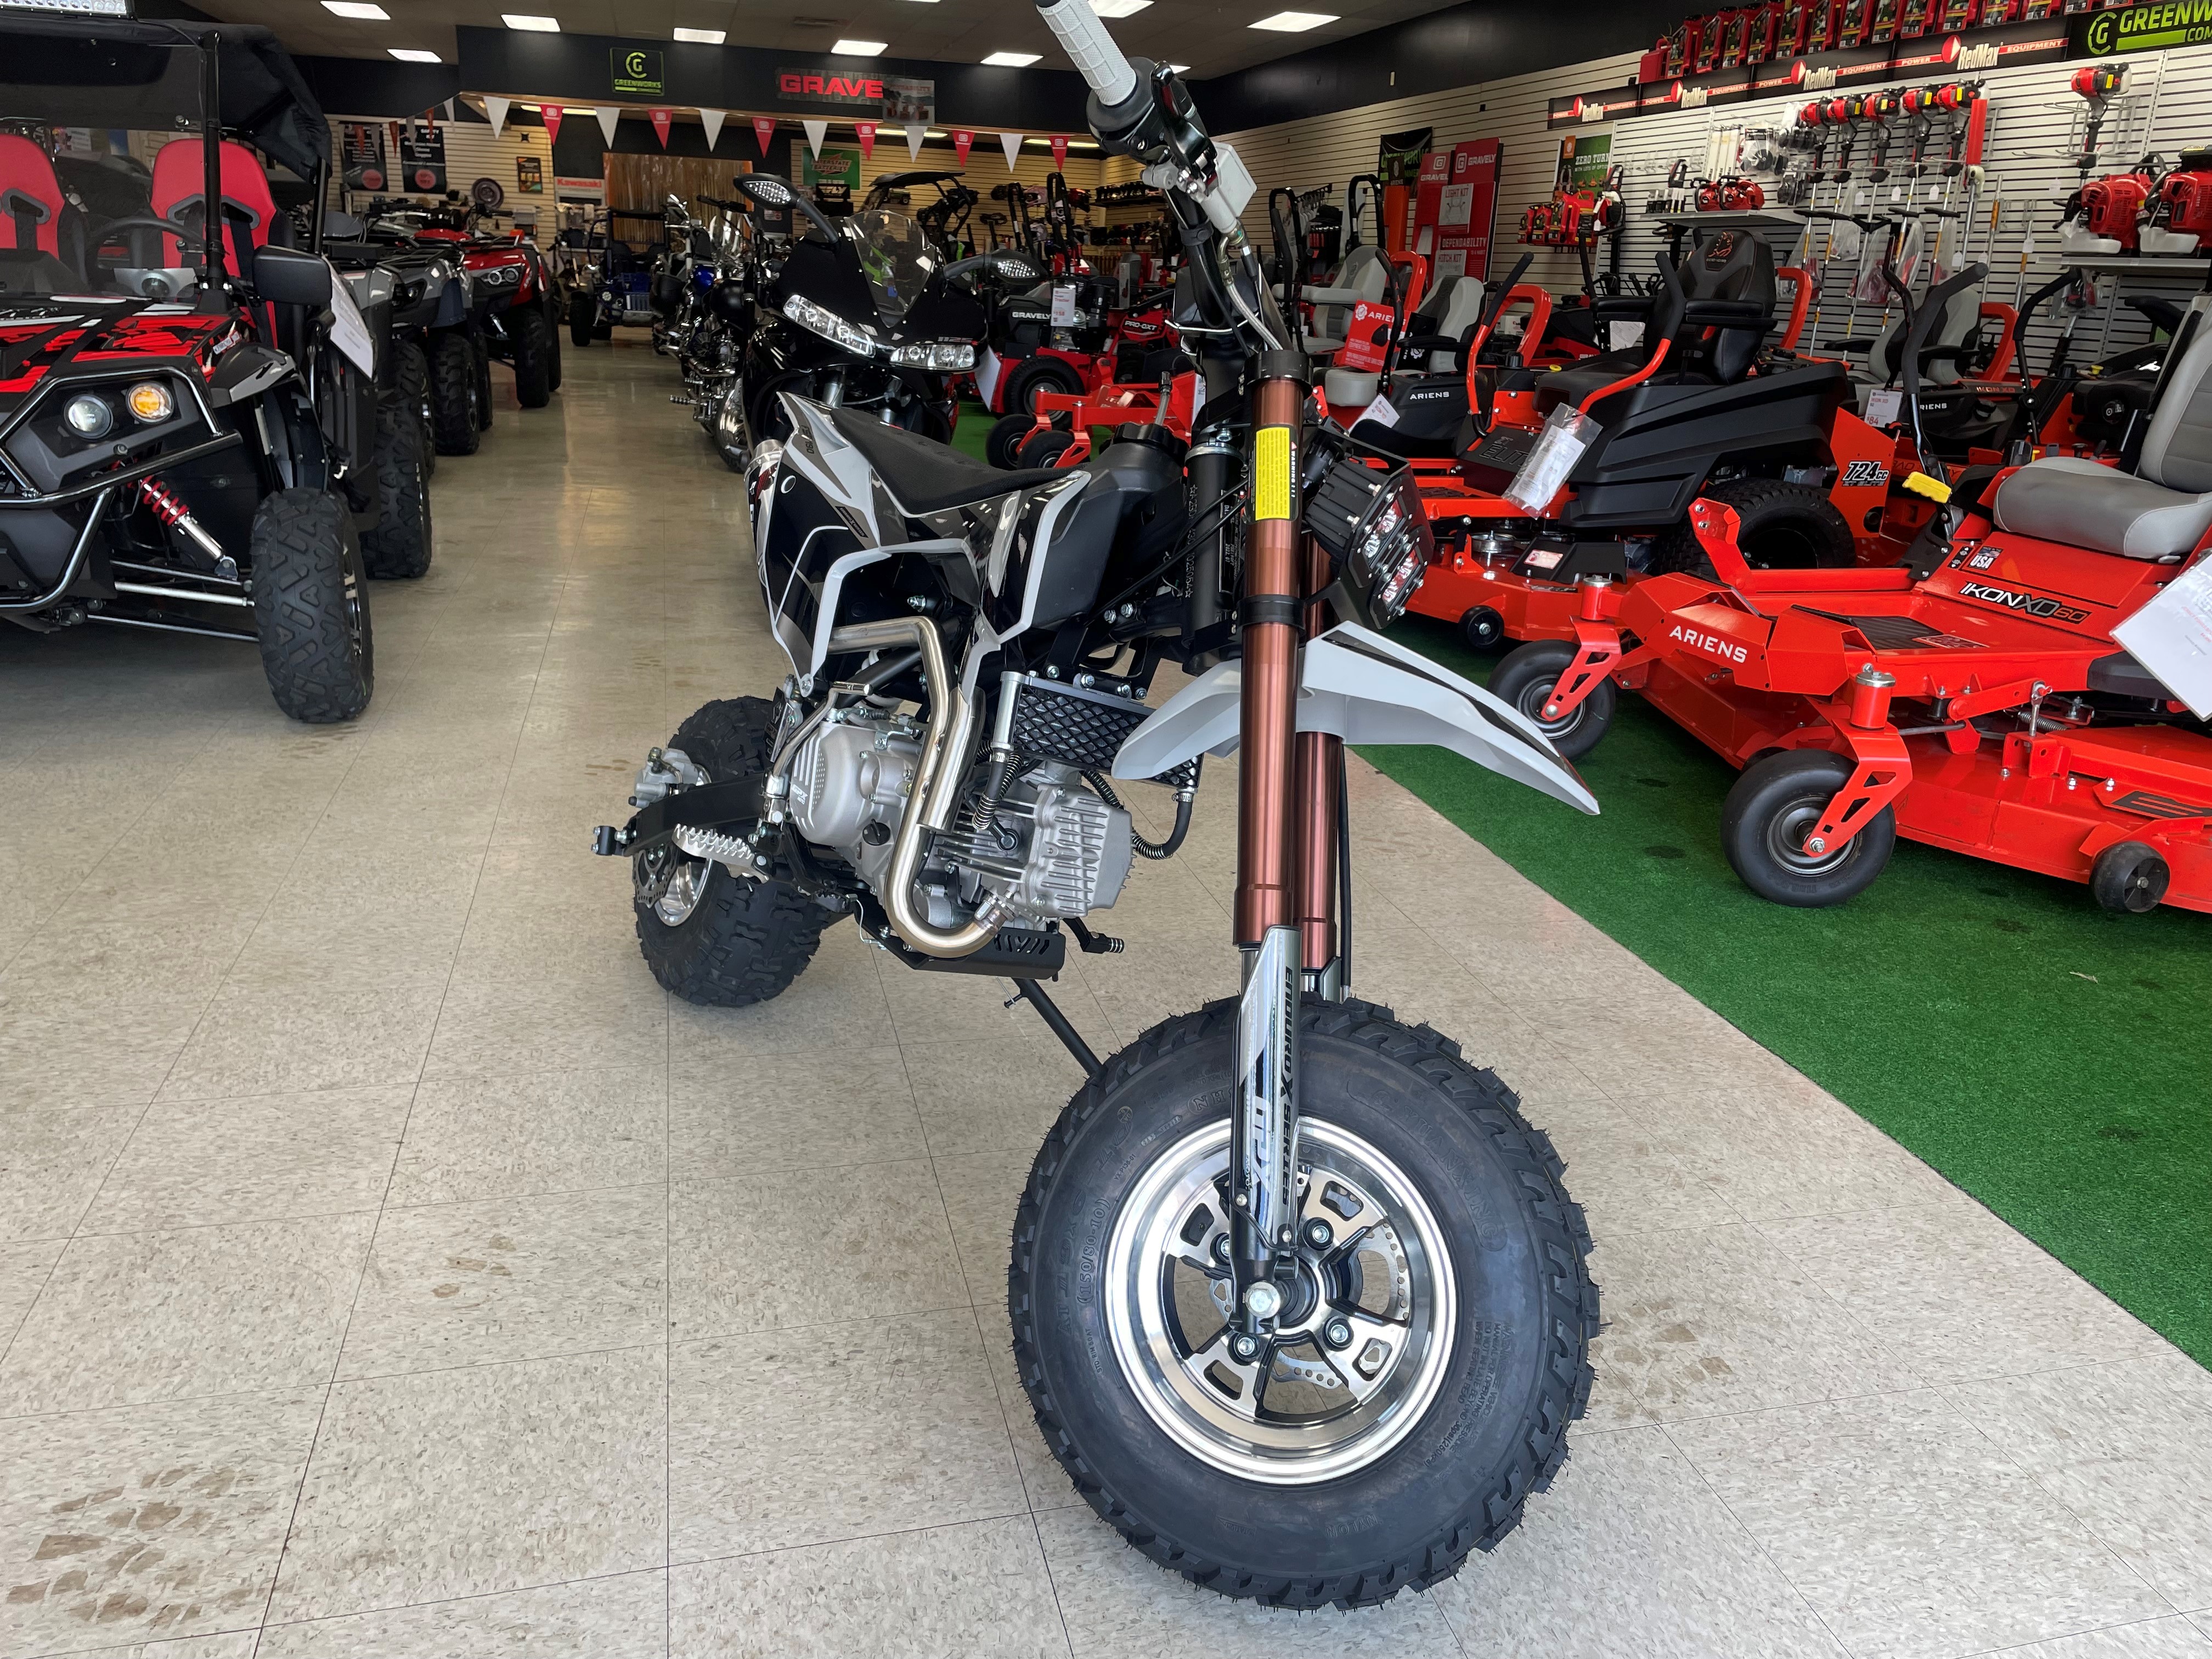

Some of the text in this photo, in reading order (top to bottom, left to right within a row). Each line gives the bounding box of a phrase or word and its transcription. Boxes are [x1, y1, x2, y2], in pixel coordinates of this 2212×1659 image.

[2119, 0, 2212, 33] GREENW
[1901, 41, 2063, 70] POWER RedMax EQUIPMENT
[780, 74, 883, 98] GRAVE
[1759, 63, 1886, 91] POWER RedMax EQUIPMENT
[1681, 87, 1708, 108] RedMax
[1712, 84, 1747, 94] EQUIPMENT
[1468, 154, 1497, 166] GRAVELY
[1575, 155, 1592, 165] ZERO
[1420, 173, 1449, 182] GRAVEL
[1446, 188, 1469, 198] LIGHT KIT
[1442, 237, 1487, 247] DEPENDABILITY
[1454, 253, 1462, 262] KIT
[1368, 311, 1406, 325] ARIES
[1410, 391, 1450, 400] ARIENS
[1479, 443, 1530, 467] ELIT
[1970, 555, 1994, 569] USA
[1669, 625, 1747, 663] ARIENS
[1283, 966, 1293, 1073] ENDURO
[1282, 1103, 1291, 1206] SERIES
[1396, 1105, 1500, 1241] YUANXING
[1076, 1195, 1114, 1304] (150/80-10)
[1088, 1346, 1097, 1358] RIM
[1481, 1335, 1491, 1356] NOT
[1455, 1320, 1483, 1405] WHEN SEATING BEAD
[1472, 1355, 1488, 1389] INFLATE
[1448, 1323, 1501, 1454] MANUAL FOR OPERATING PRESSURE
[1458, 1388, 1479, 1422] BEYOND
[1323, 1511, 1380, 1541] NYLON
